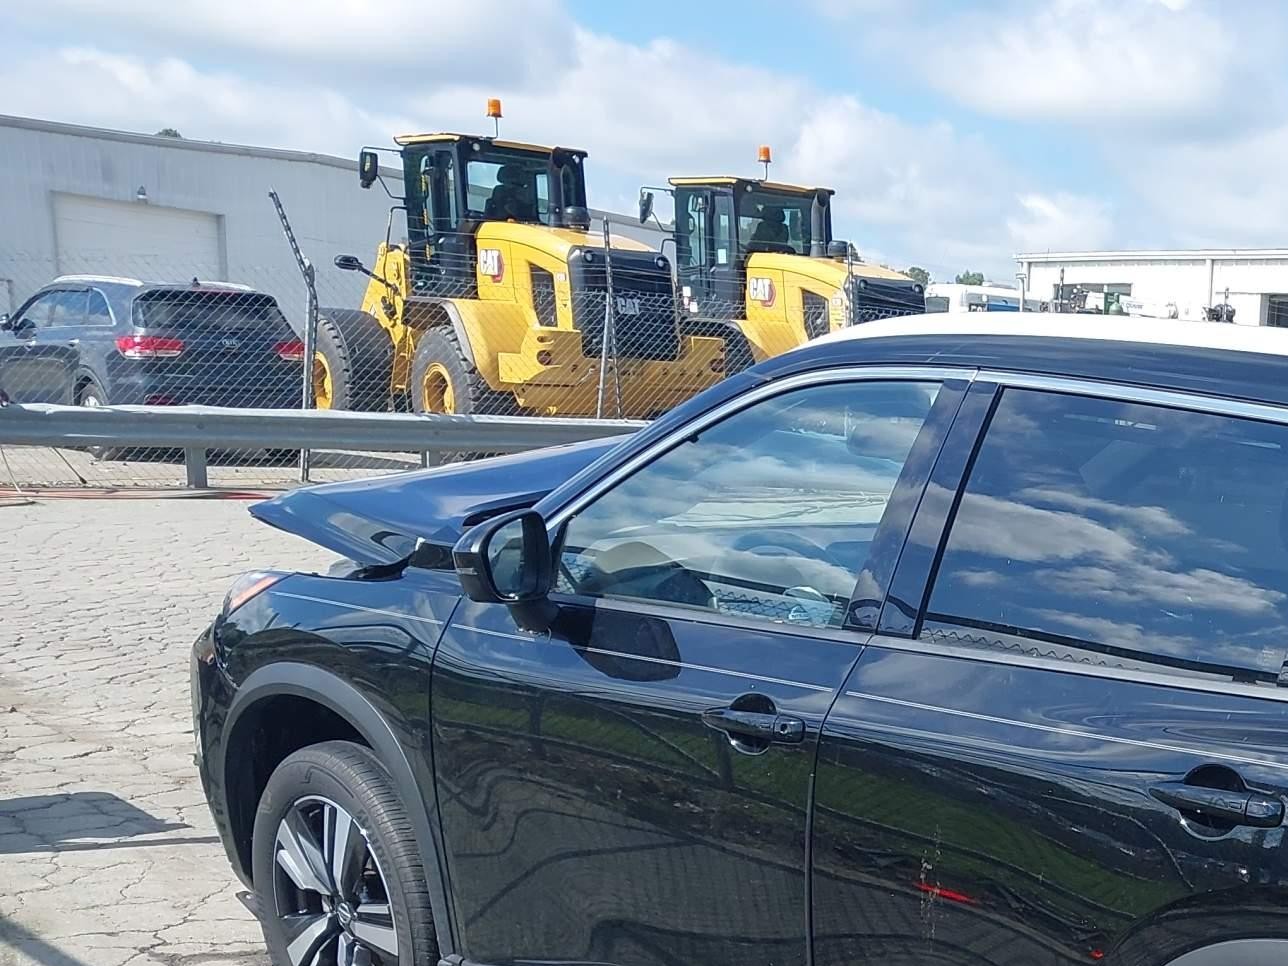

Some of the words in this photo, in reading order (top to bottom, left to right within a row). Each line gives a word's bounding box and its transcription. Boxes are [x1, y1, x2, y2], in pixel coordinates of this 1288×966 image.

[480, 249, 499, 276] CAT
[750, 277, 770, 301] CAT
[616, 295, 640, 314] CAT
